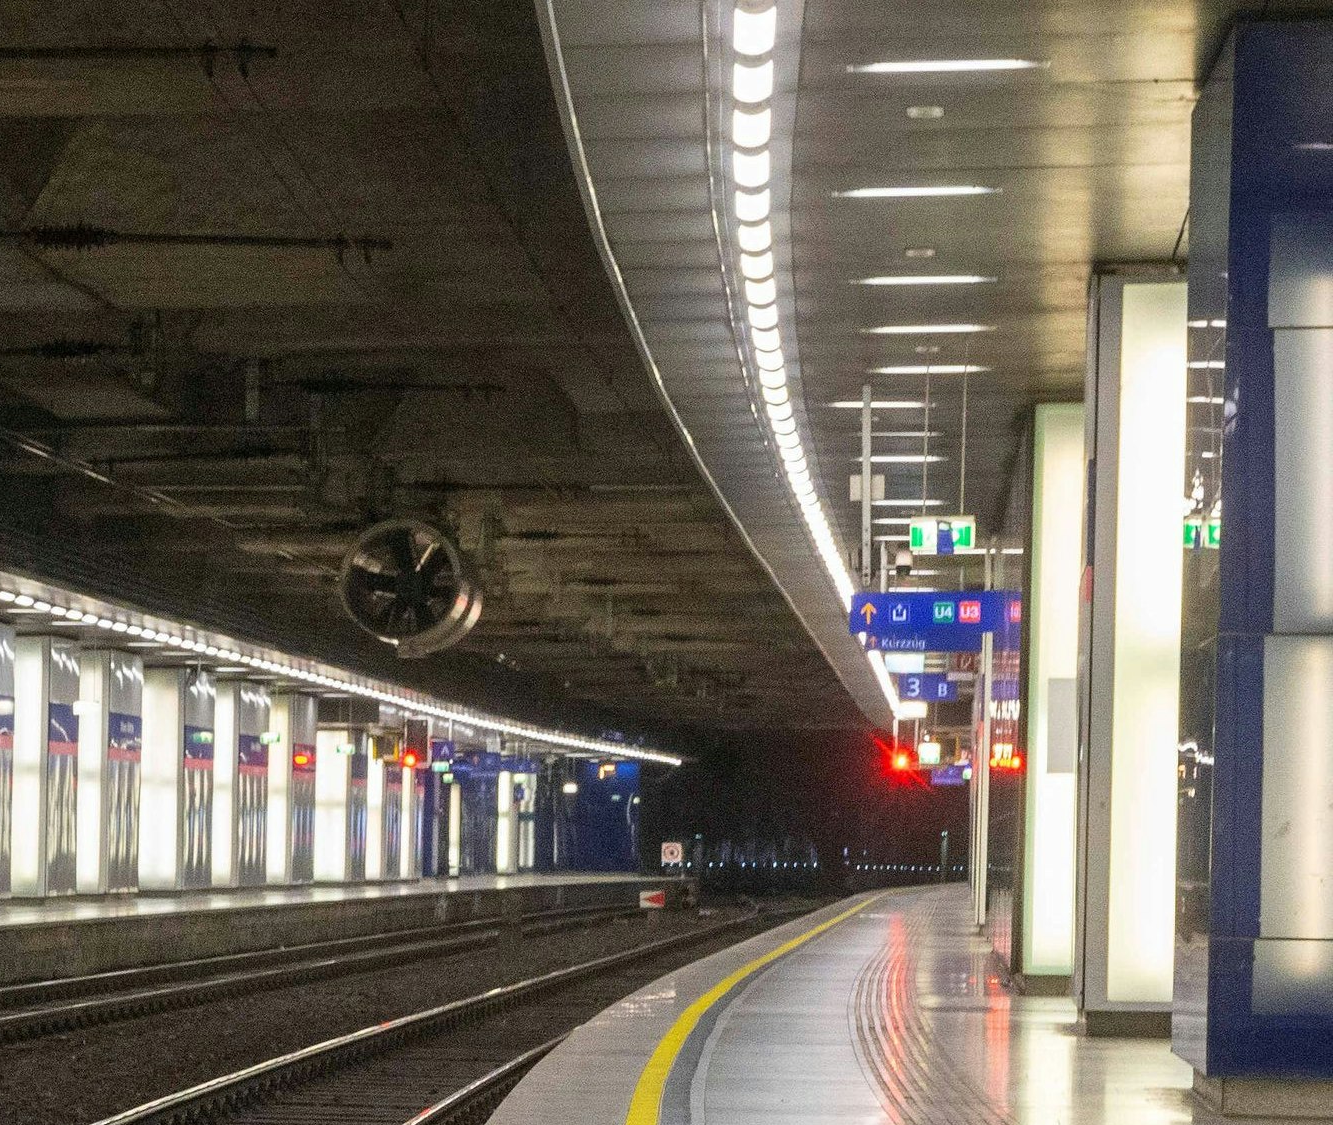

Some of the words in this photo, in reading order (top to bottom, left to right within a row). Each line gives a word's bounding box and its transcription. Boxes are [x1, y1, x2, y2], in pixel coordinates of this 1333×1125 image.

[935, 606, 952, 618] U4
[959, 605, 979, 618] U3
[907, 677, 920, 698] 3
[938, 683, 948, 698] B
